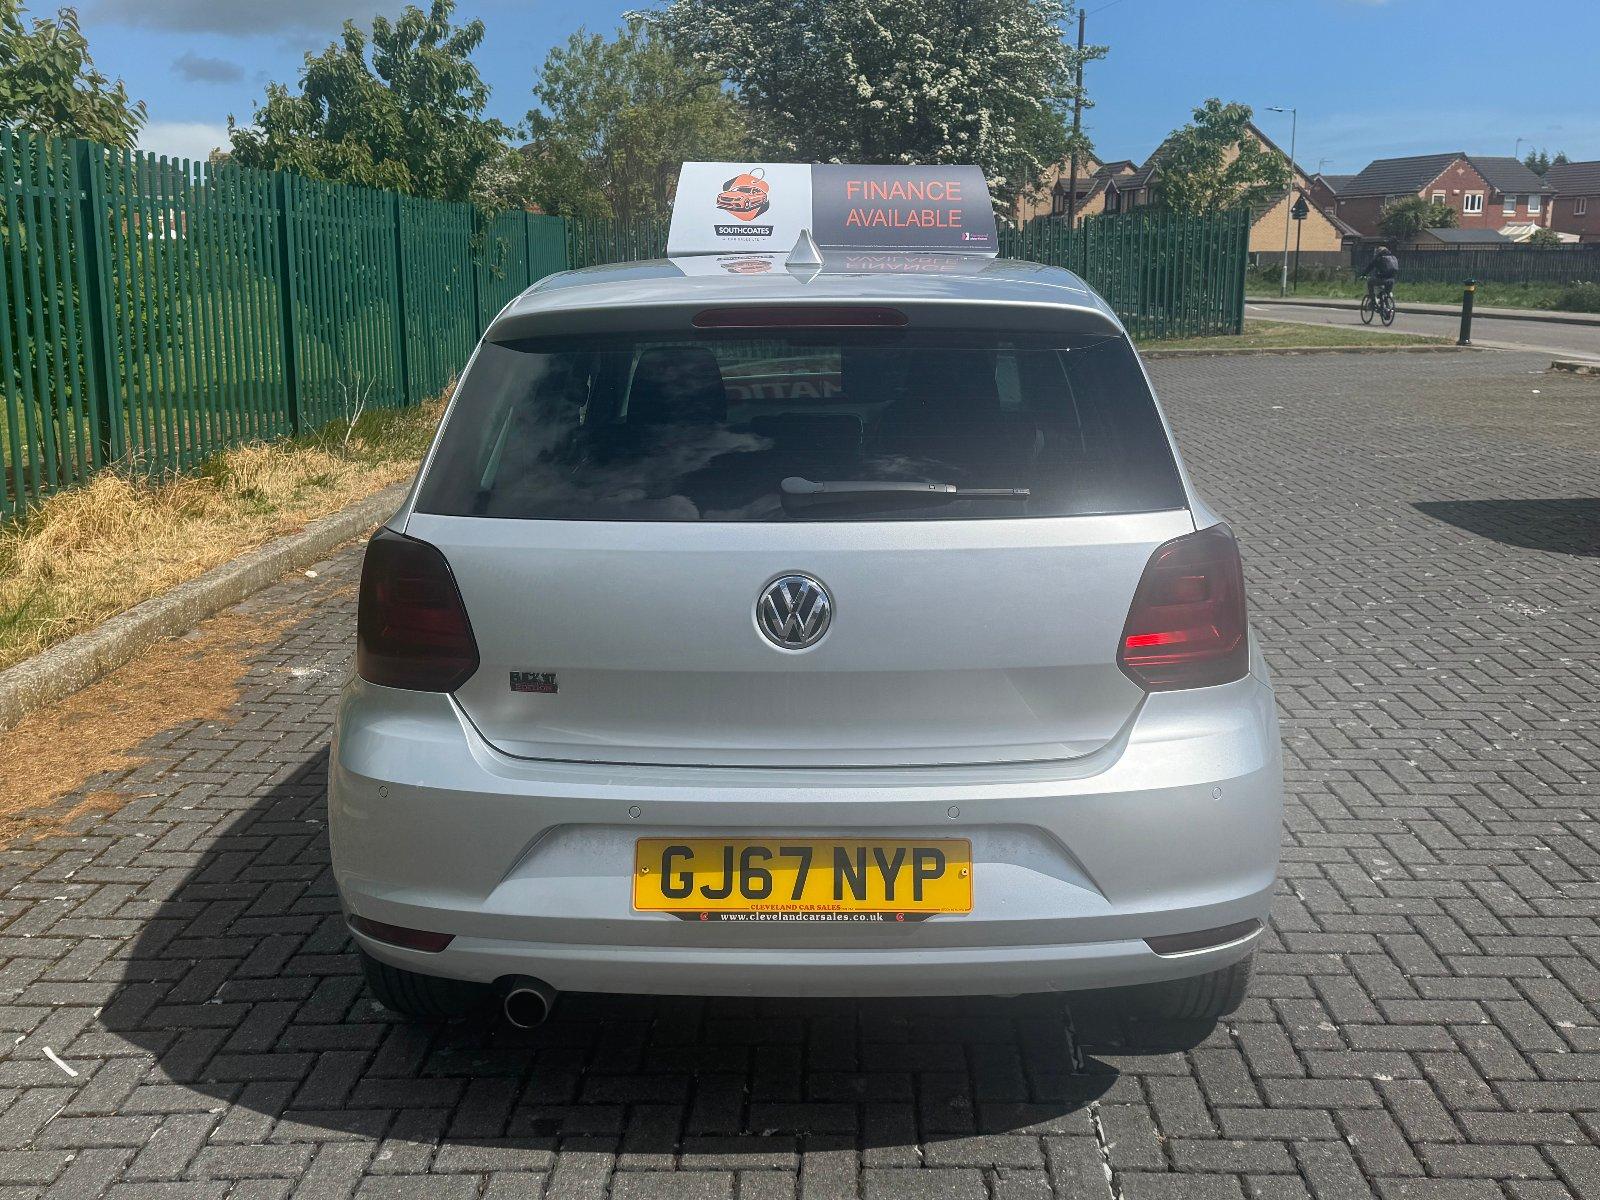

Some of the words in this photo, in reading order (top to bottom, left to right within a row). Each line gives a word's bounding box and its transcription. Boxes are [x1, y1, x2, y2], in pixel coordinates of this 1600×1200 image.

[846, 180, 962, 200] FINANCE
[846, 208, 962, 227] AVAILABLE
[718, 226, 770, 235] SOUTHCOATES
[661, 845, 813, 901] GJ67
[833, 846, 946, 902] NYP
[720, 911, 884, 921] www.clevelandcarsales.co.uk
